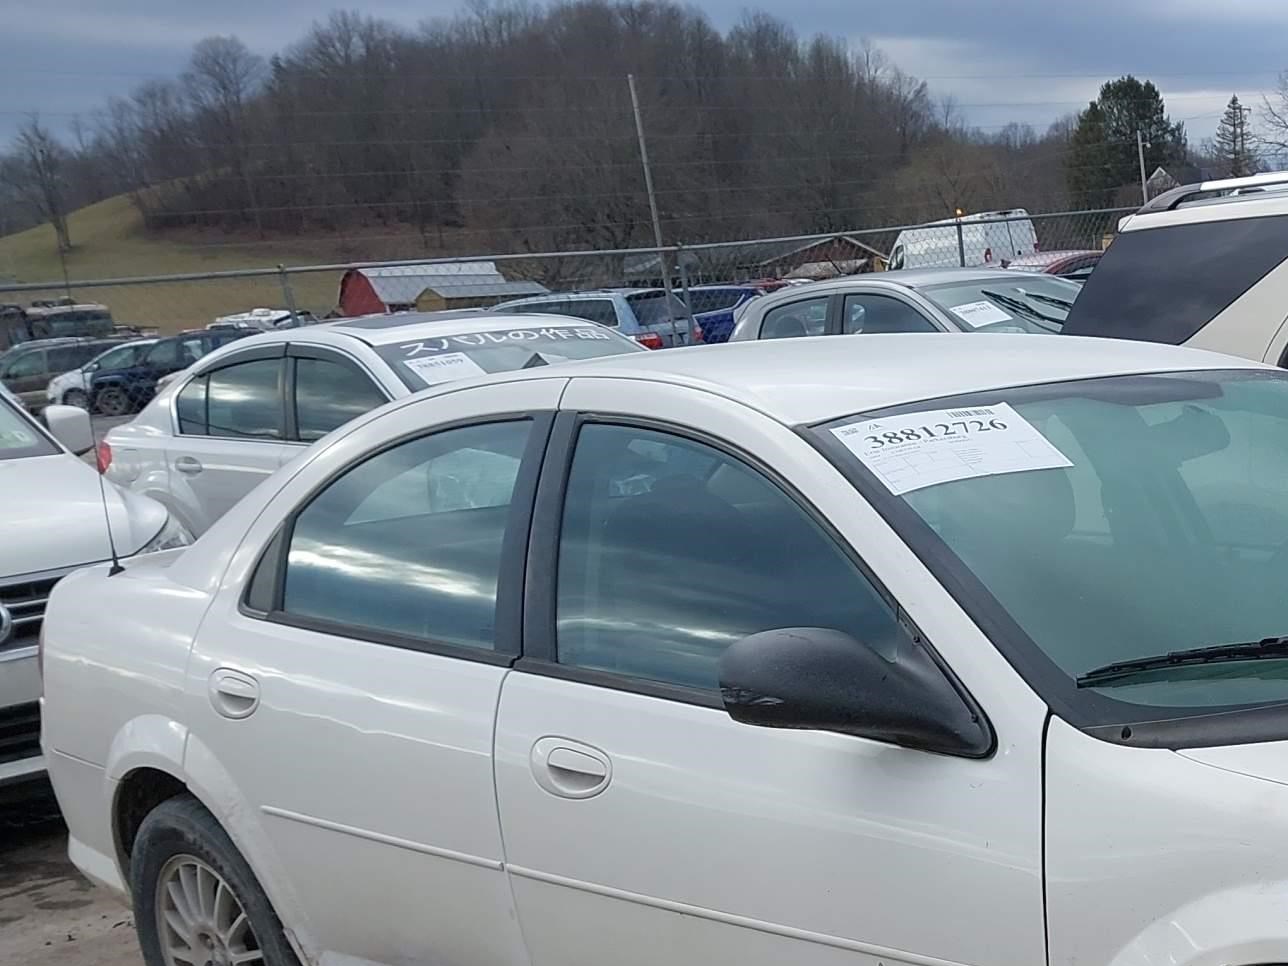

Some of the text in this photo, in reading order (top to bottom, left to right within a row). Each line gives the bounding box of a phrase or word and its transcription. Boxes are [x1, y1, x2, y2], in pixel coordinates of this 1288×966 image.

[399, 327, 610, 356] スバルの作品
[863, 416, 1008, 450] 38812726
